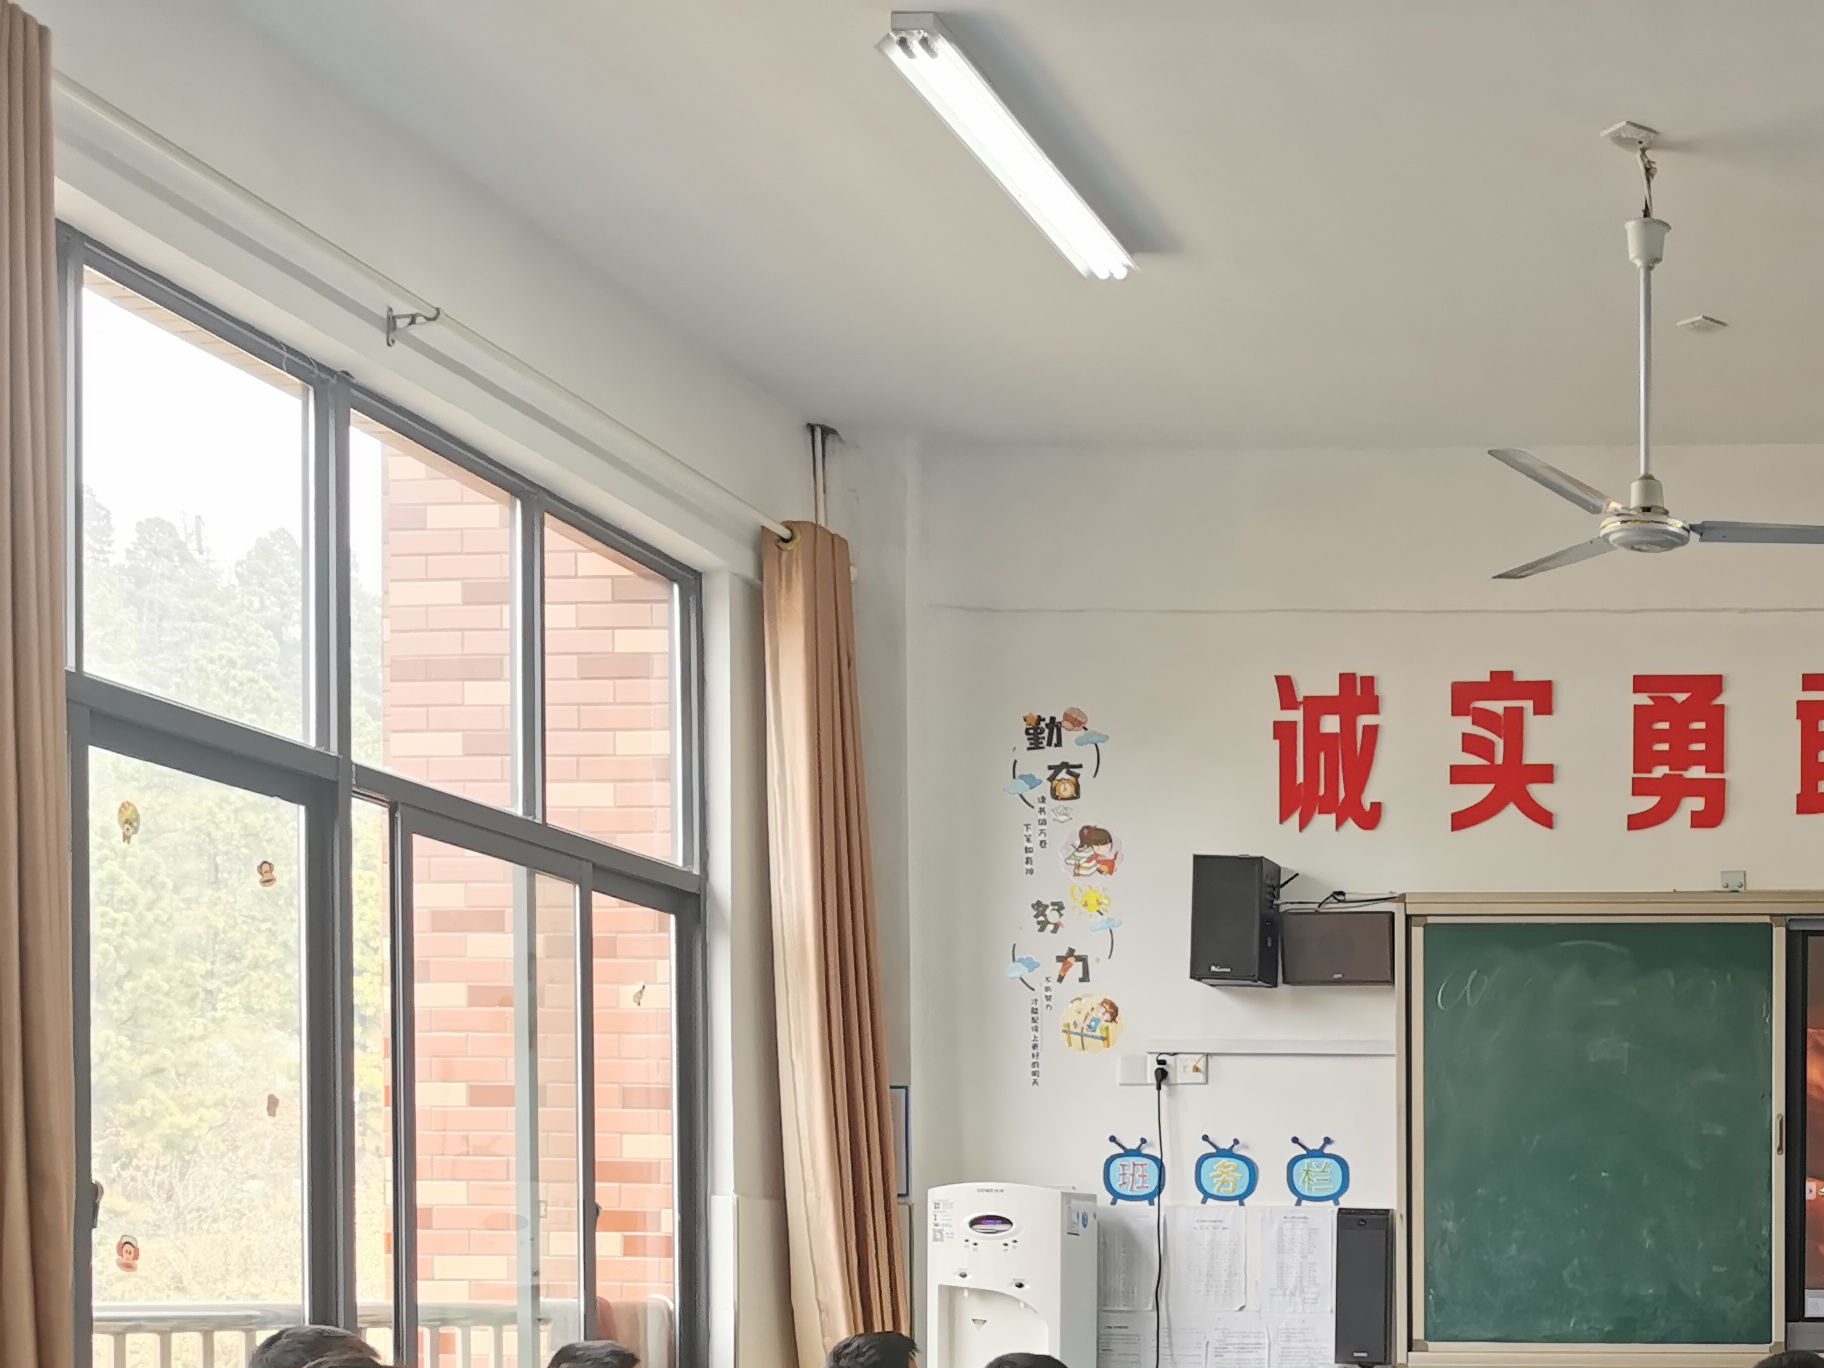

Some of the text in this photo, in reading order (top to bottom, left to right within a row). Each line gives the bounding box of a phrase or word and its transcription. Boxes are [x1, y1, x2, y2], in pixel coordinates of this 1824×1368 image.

[1024, 714, 1083, 801] 勤奋
[1031, 900, 1091, 984] 努力
[1117, 1161, 1334, 1193] 班务栏
